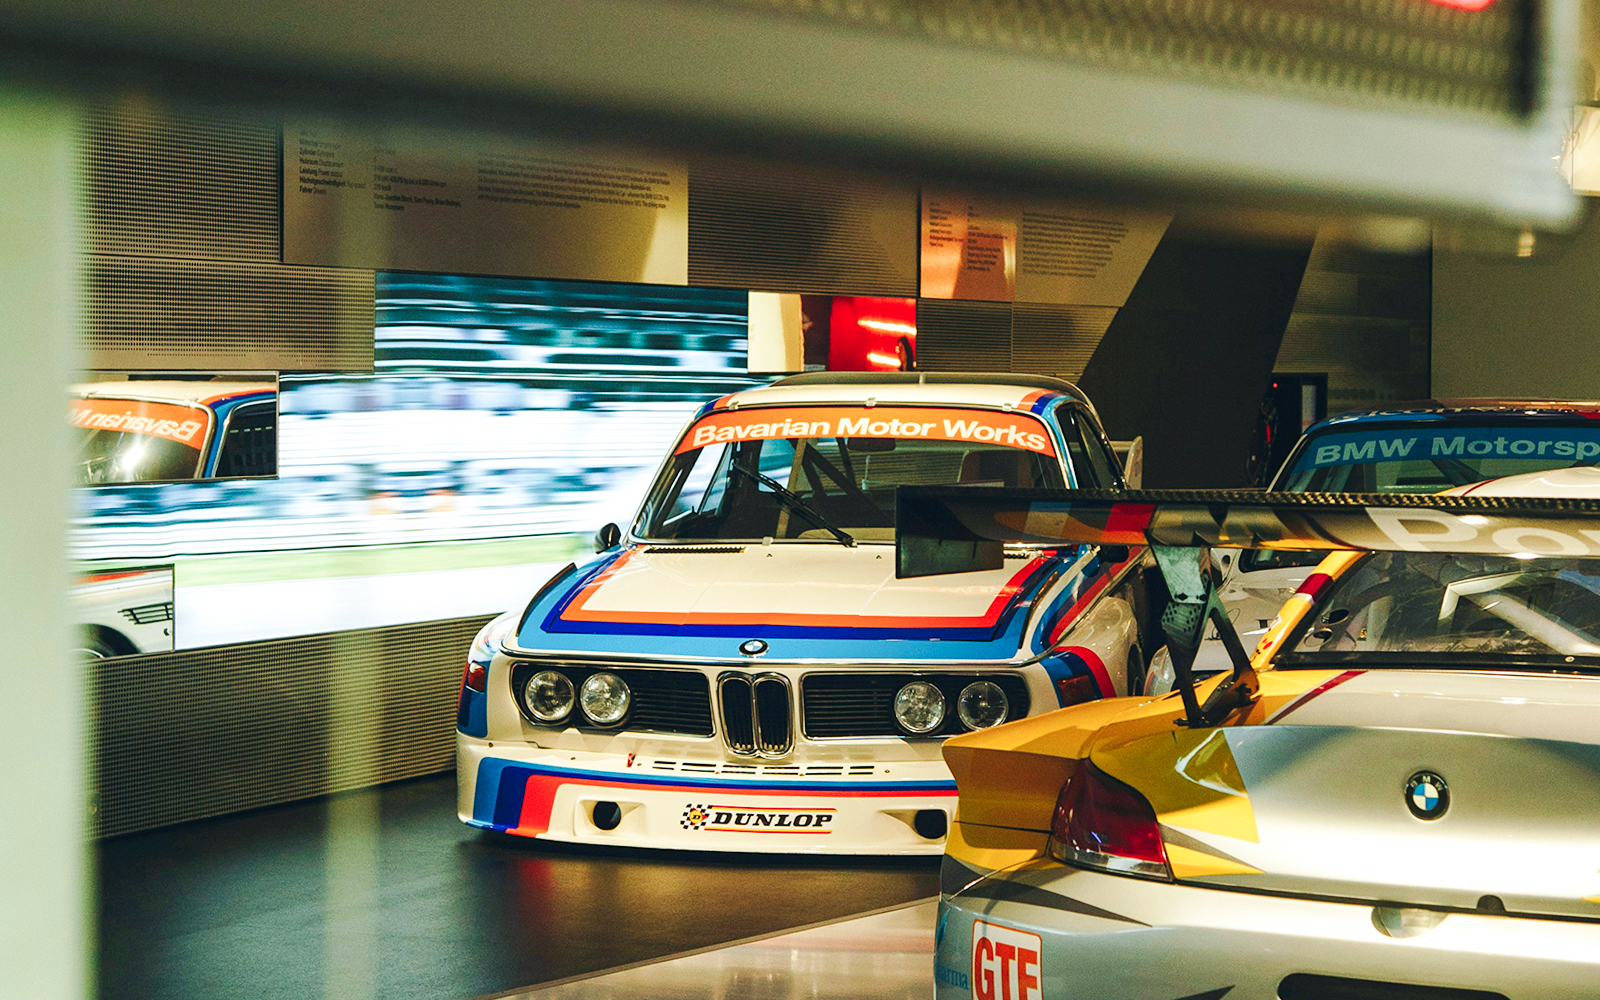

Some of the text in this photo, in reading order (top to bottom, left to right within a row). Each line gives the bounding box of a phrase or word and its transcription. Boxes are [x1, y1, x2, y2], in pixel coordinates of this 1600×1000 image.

[692, 417, 1047, 450] Bavarian Motor Works
[1315, 436, 1600, 465] BMW Motorsp
[1365, 507, 1600, 557] Po
[711, 811, 833, 828] DUNLOP
